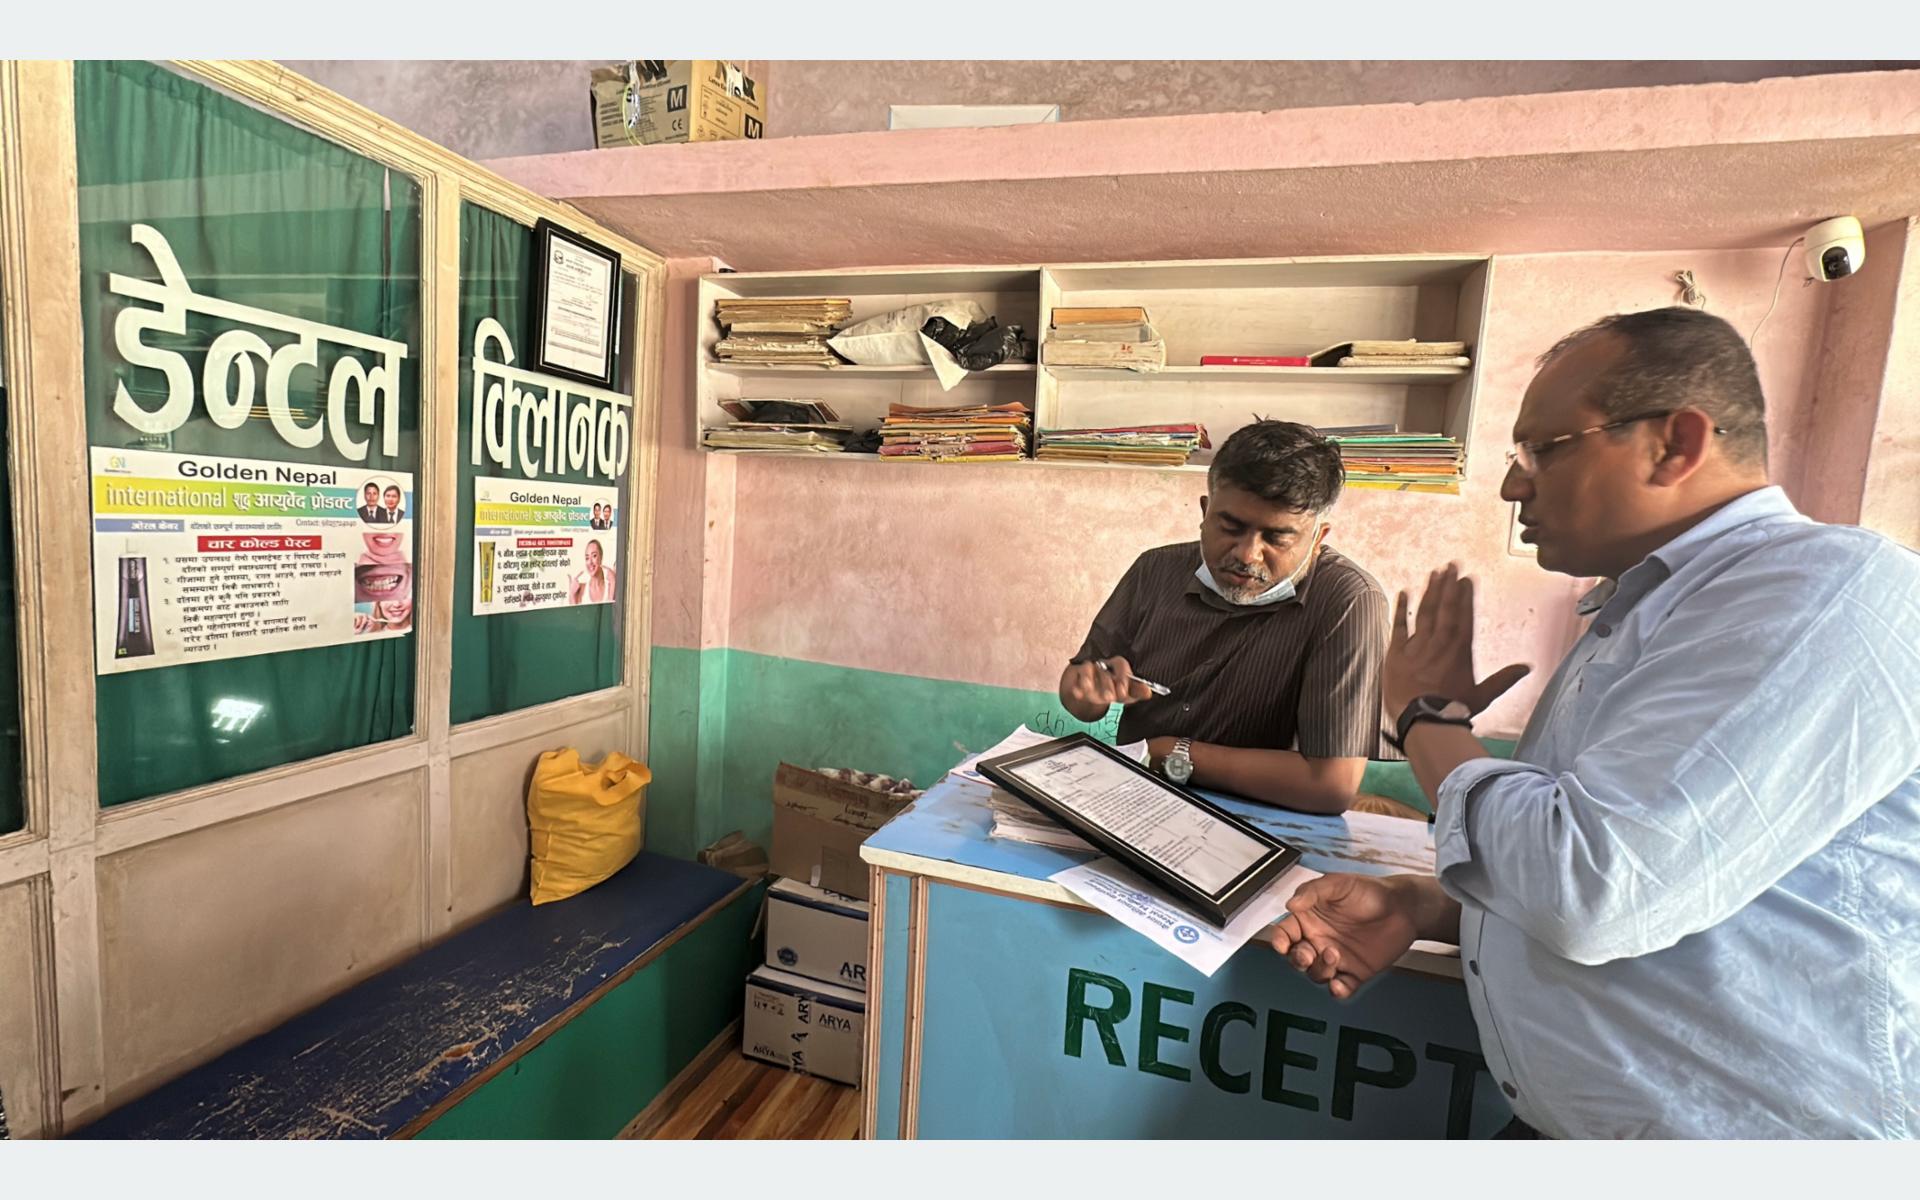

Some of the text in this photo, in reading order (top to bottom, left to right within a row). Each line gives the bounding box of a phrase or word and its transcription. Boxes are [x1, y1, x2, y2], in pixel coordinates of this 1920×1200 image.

[109, 223, 408, 461] डेन्टल
[178, 460, 336, 486] Golden Nepal
[106, 483, 227, 508] international
[254, 490, 306, 512] आयुर्वेद
[510, 492, 581, 507] Golden Nepal
[240, 537, 280, 549] कोल्ड
[284, 536, 313, 548] पेस्ट
[840, 962, 866, 981] AR
[819, 1013, 851, 1031] ARYA
